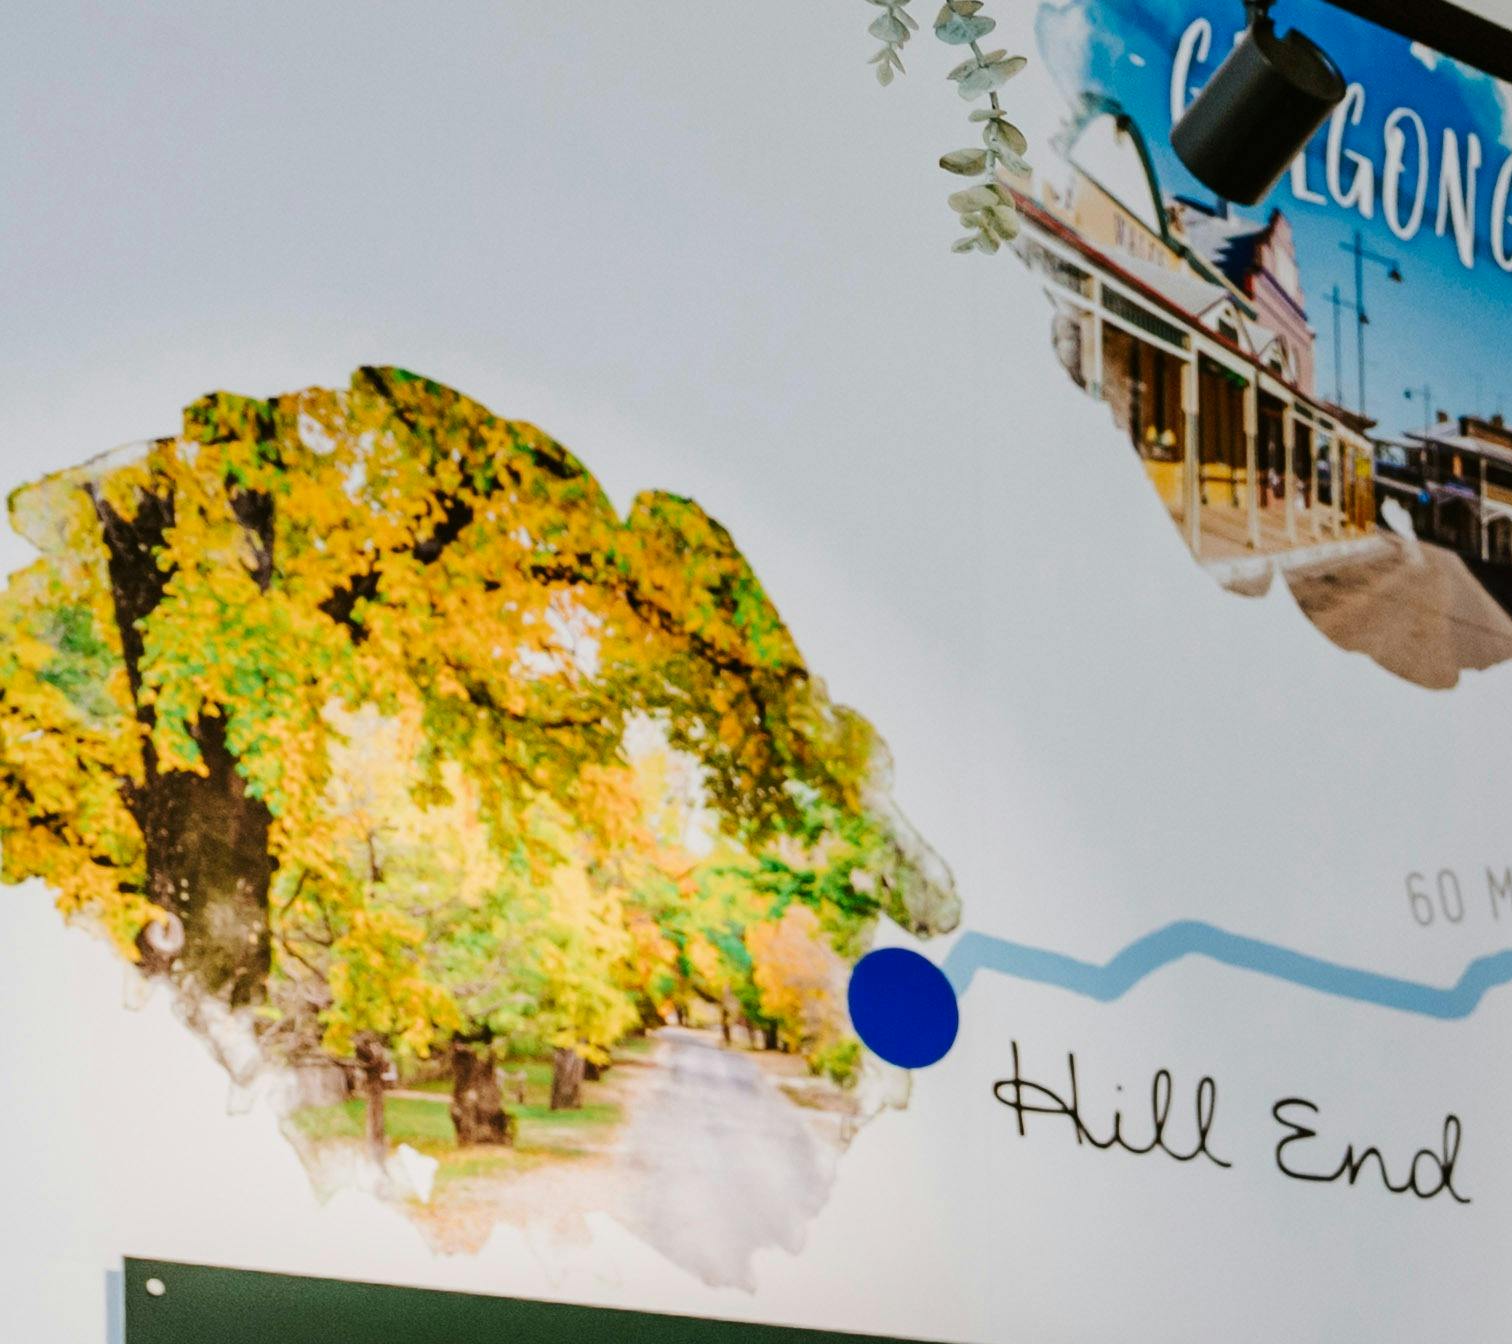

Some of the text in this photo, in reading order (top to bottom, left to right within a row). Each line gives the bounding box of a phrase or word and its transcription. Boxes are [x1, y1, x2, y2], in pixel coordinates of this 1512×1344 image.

[1405, 870, 1466, 928] 60
[993, 1039, 1473, 1204] Hill End
